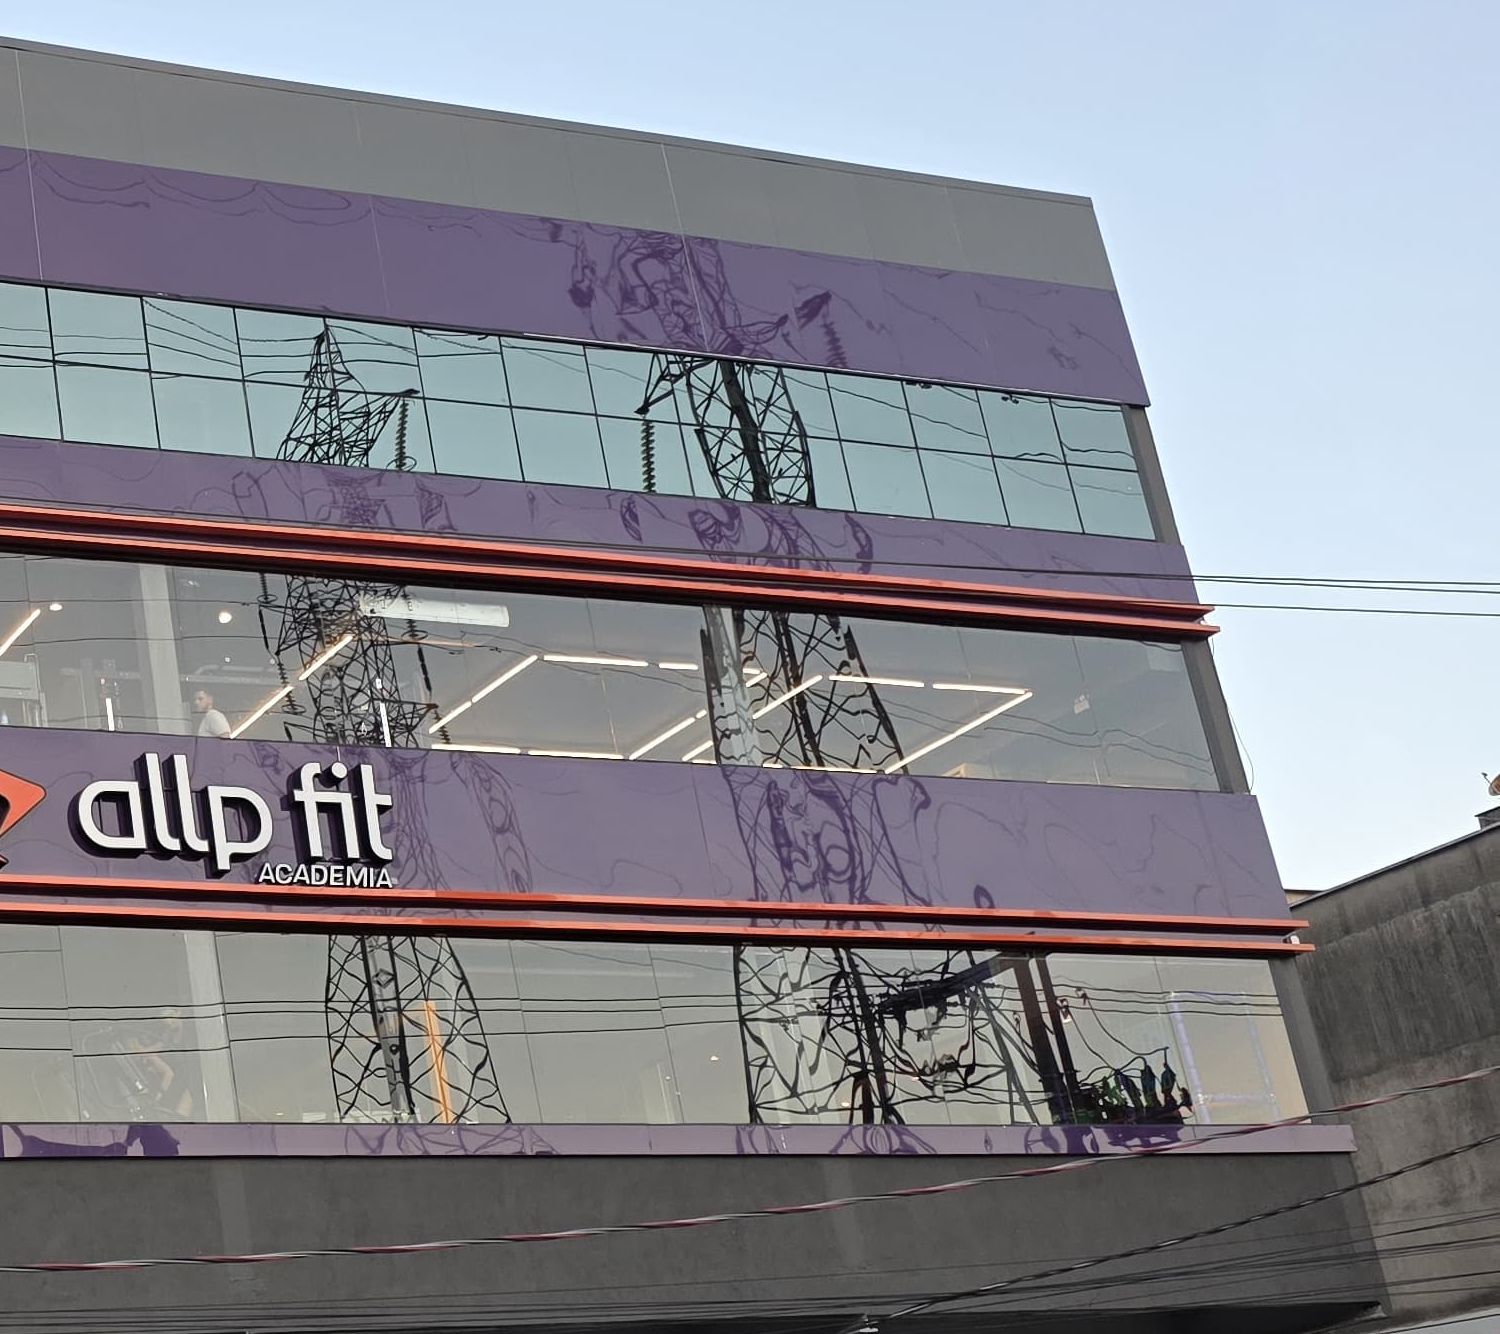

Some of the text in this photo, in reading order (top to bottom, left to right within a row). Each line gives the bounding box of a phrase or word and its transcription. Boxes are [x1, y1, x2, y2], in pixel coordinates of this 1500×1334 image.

[77, 752, 394, 871] allp fit
[257, 863, 394, 889] ACADEMIA
